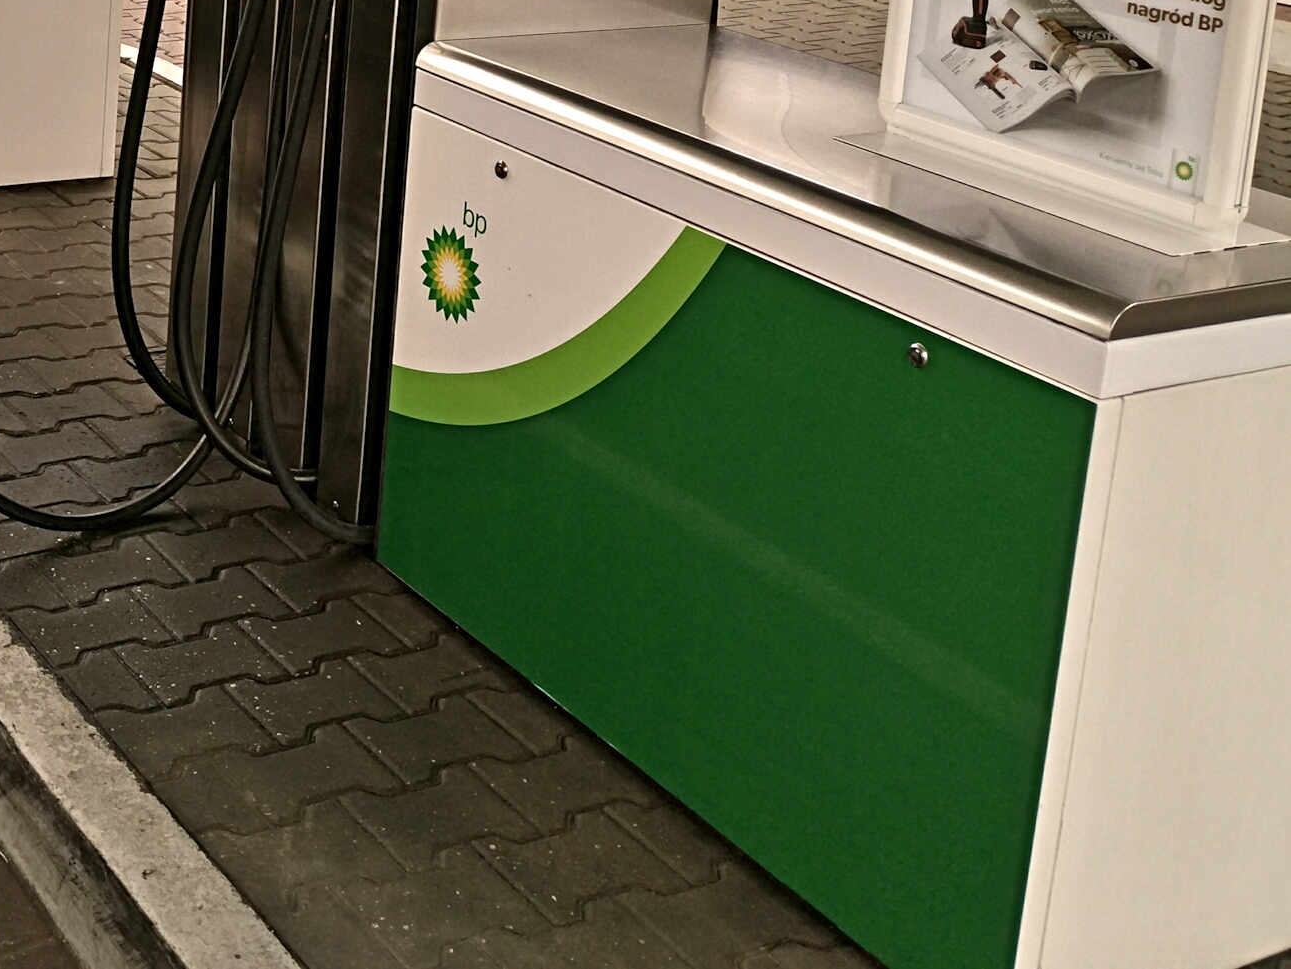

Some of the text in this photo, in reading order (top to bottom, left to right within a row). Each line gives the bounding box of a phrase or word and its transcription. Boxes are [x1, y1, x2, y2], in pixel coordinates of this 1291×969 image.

[1127, 2, 1223, 33] nagród BP
[463, 201, 487, 238] bp
